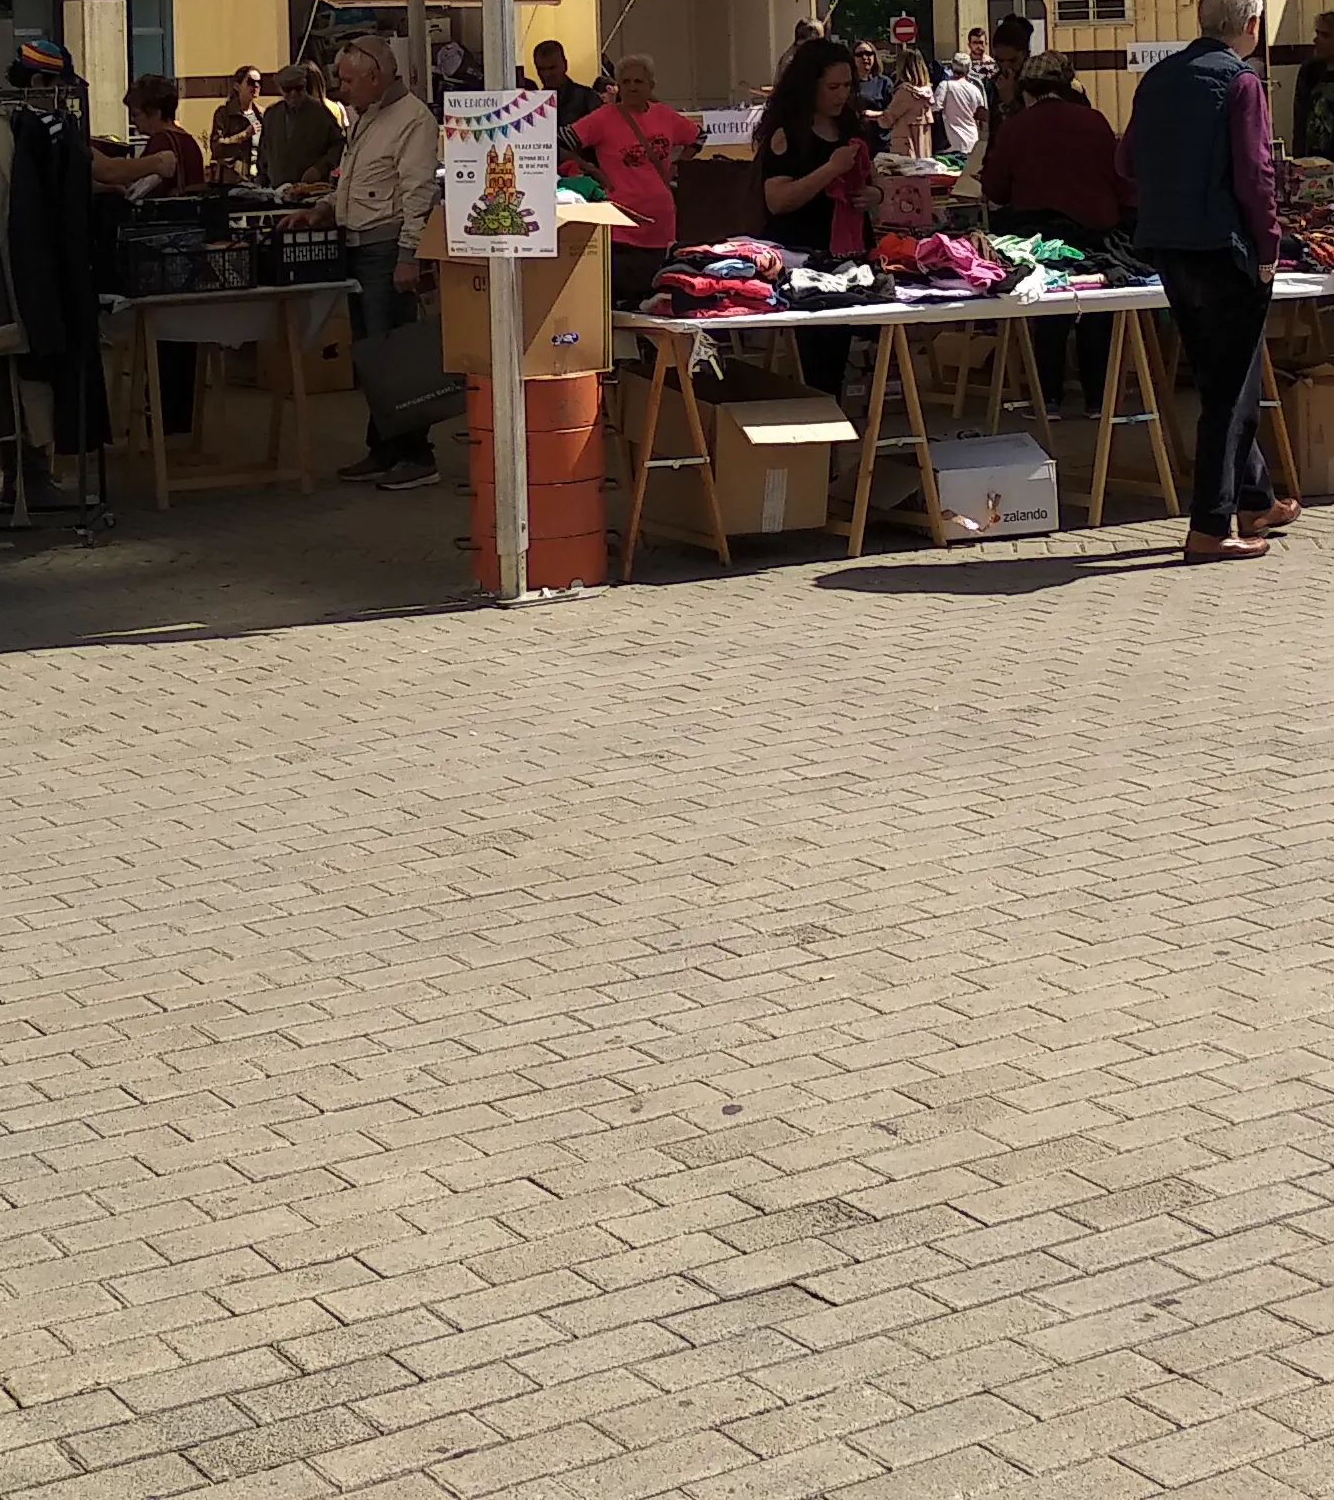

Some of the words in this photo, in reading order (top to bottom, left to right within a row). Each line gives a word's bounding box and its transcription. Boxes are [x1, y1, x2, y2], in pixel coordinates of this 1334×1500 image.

[448, 98, 462, 108] XIX
[464, 96, 498, 108] EDICIÓN
[1003, 508, 1048, 522] zalando
